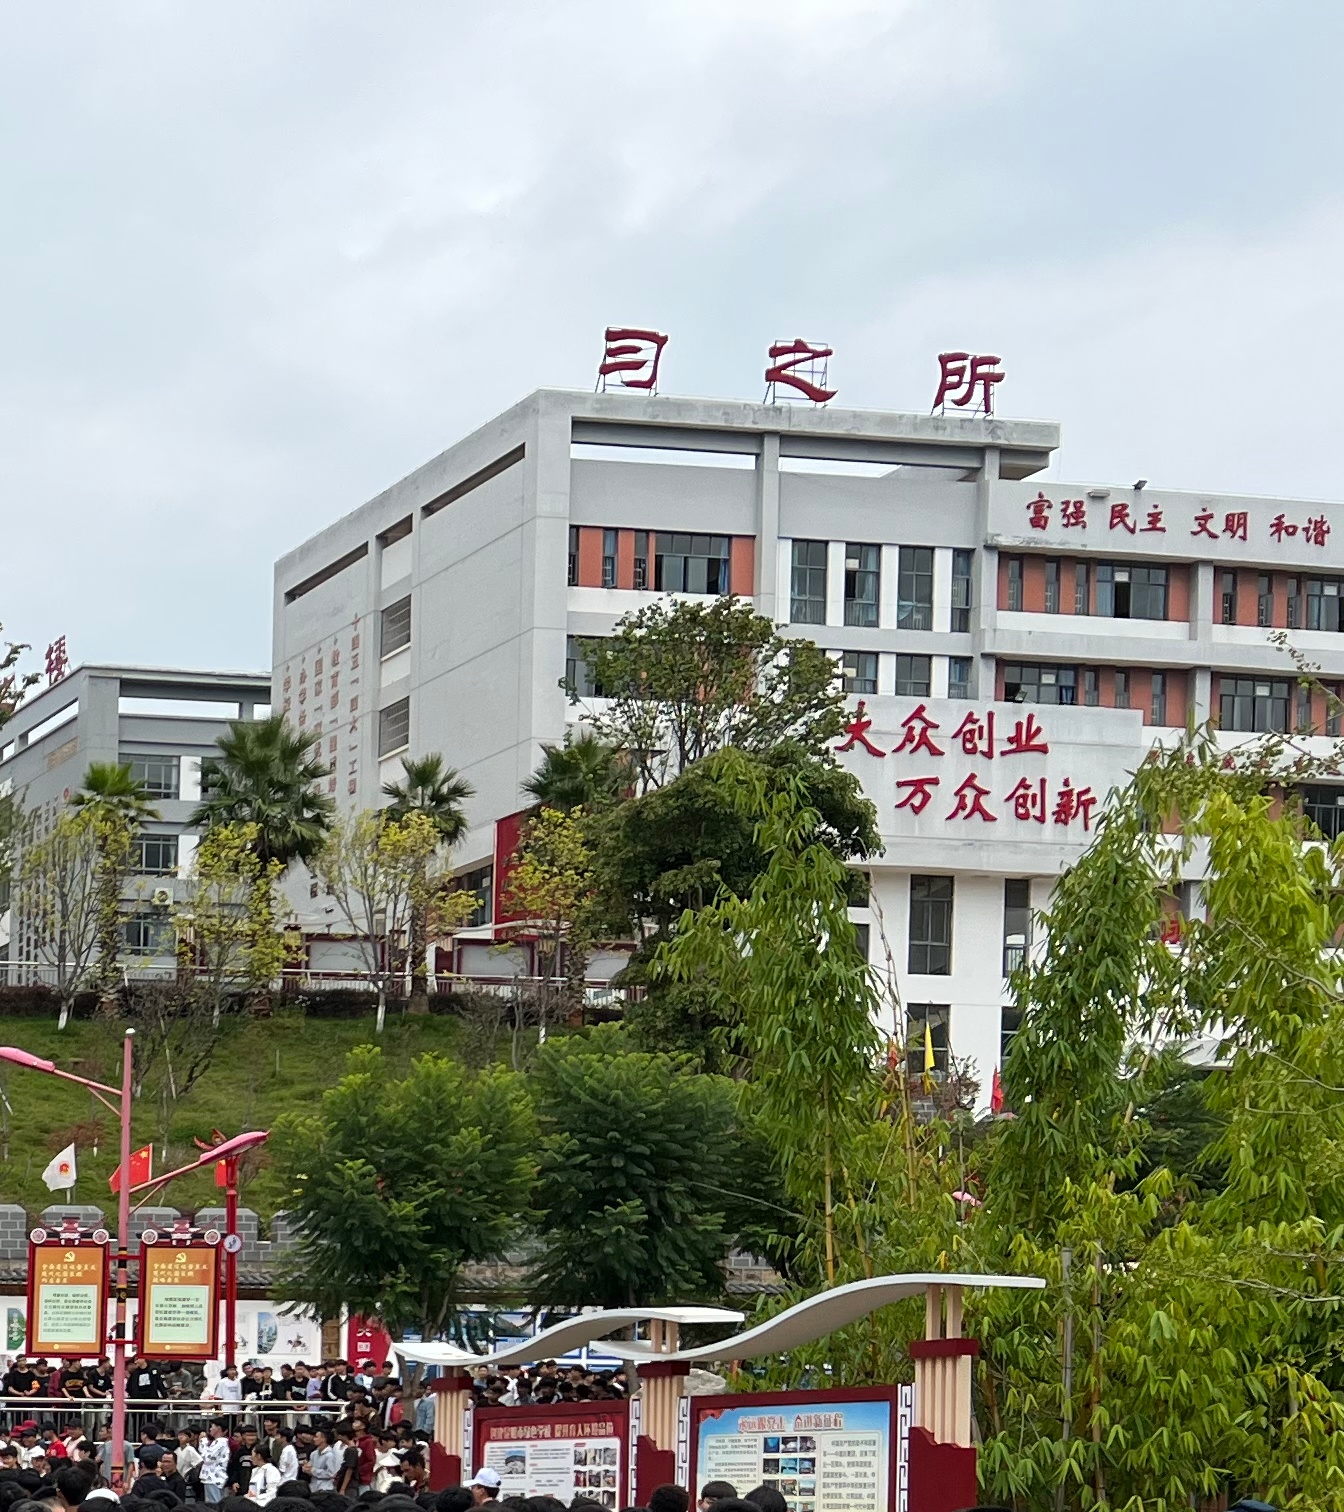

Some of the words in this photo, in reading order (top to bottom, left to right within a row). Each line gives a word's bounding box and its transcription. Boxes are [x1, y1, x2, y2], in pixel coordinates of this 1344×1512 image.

[599, 327, 1006, 414] 习之所
[1026, 492, 1088, 531] 富强
[1109, 503, 1168, 534] 民主
[1190, 507, 1250, 540] 文明
[1270, 512, 1332, 547] 和谐
[834, 700, 1050, 760] 大众创业
[895, 772, 1098, 832] 万众创新
